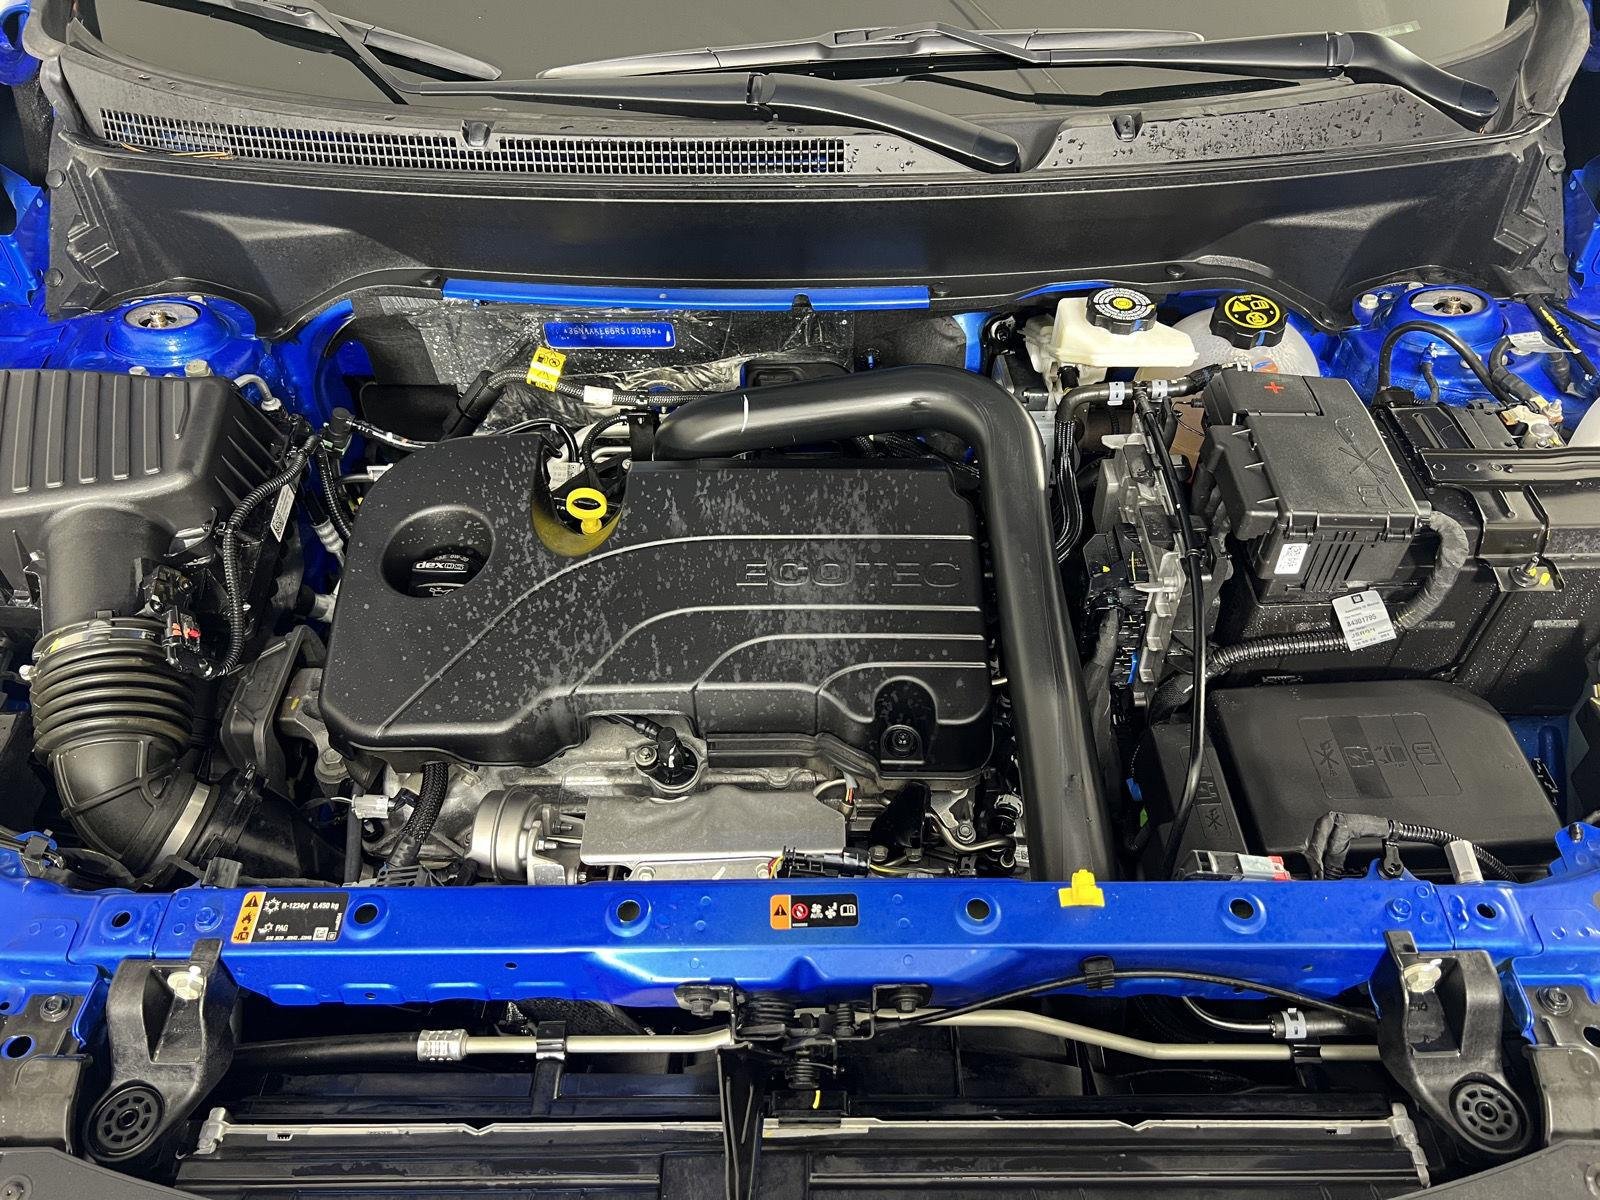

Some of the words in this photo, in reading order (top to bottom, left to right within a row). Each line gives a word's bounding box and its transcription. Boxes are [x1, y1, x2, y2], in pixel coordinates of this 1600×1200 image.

[415, 561, 465, 571] dexos
[735, 562, 961, 588] ECOTEC
[281, 902, 310, 911] R-1234yf
[331, 902, 340, 911] kg
[274, 924, 289, 932] PAG
